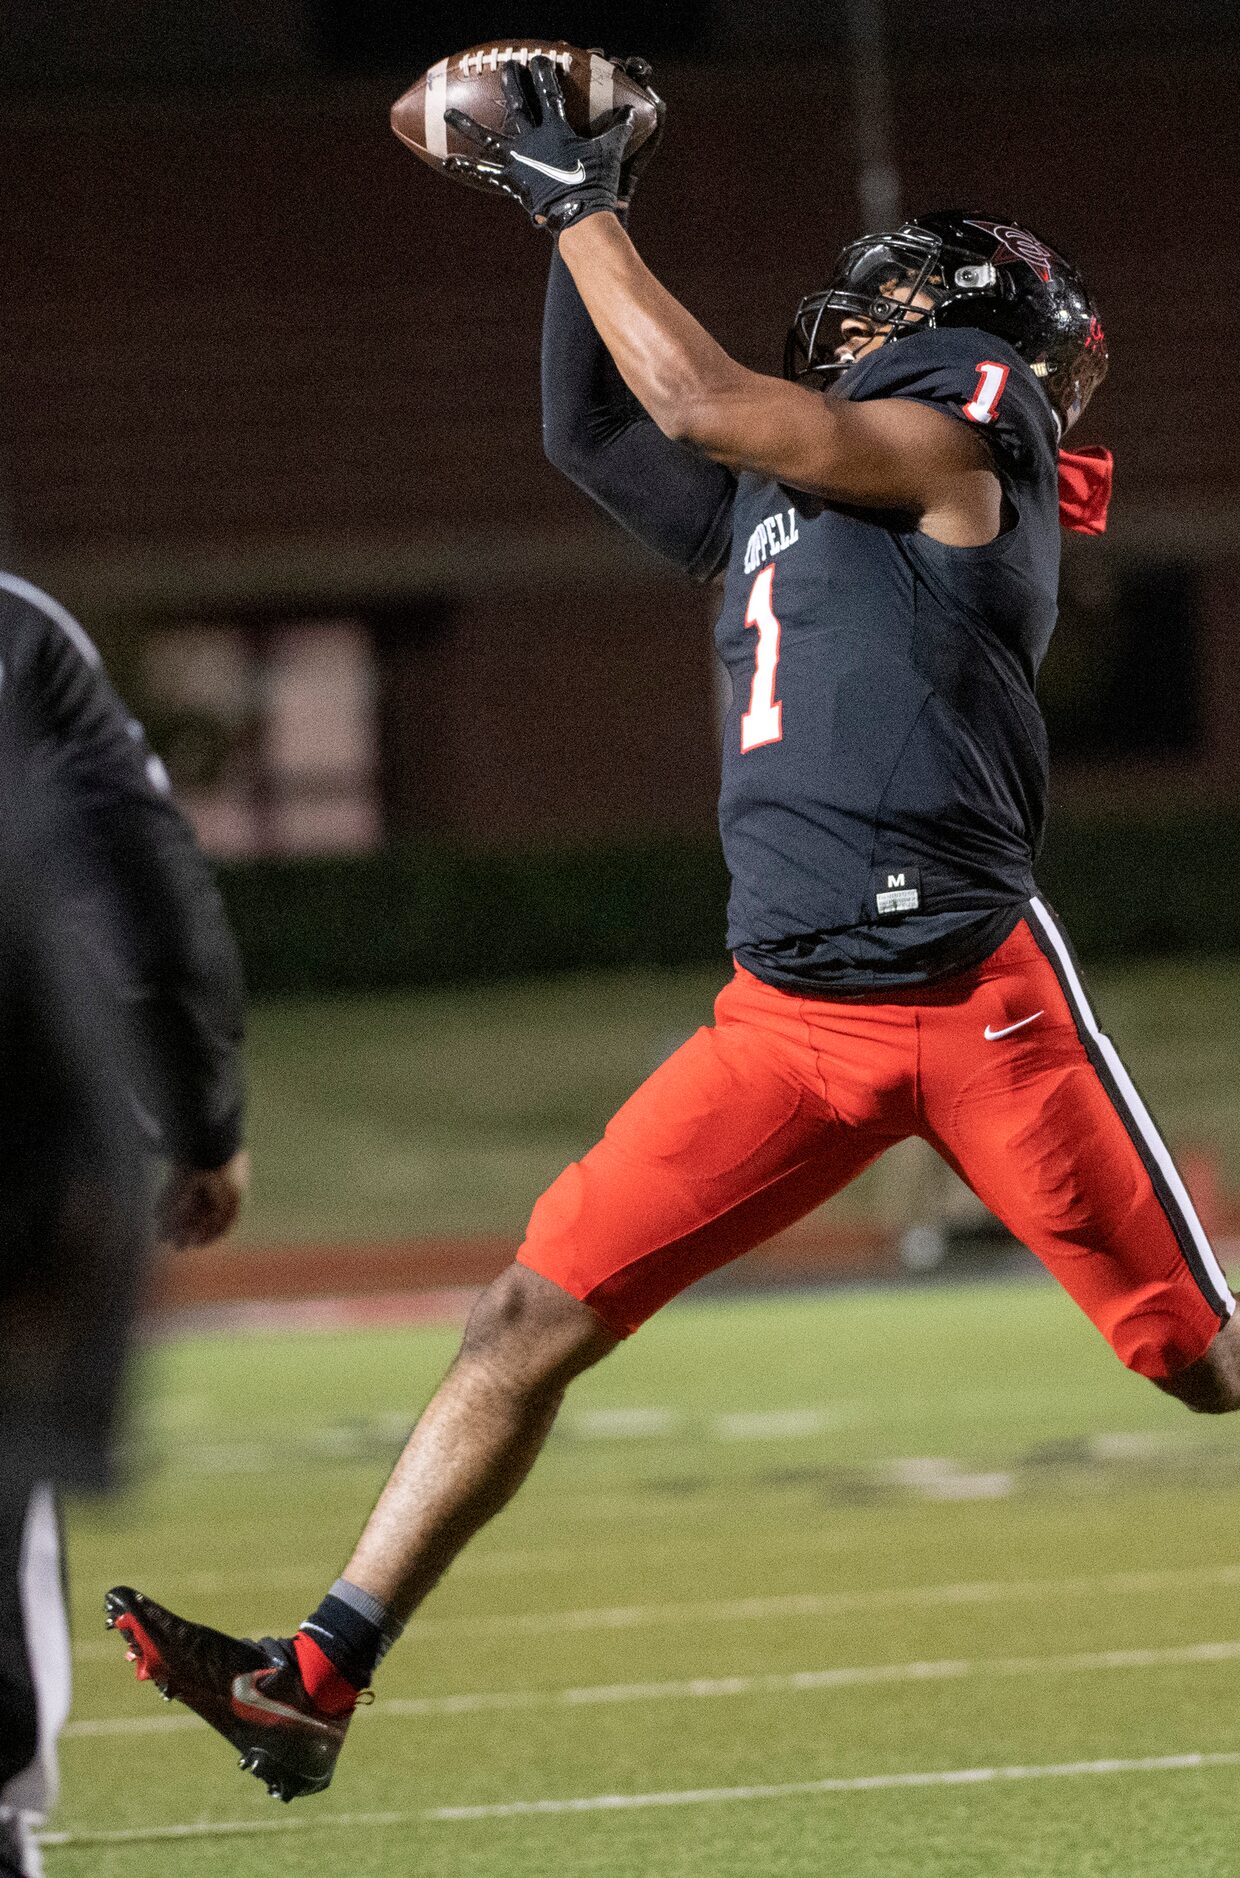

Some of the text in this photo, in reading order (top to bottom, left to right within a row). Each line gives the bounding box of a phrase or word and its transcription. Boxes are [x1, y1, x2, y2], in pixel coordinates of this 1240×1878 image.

[962, 360, 1011, 424] 1
[739, 562, 784, 755] 1
[887, 873, 905, 888] M
